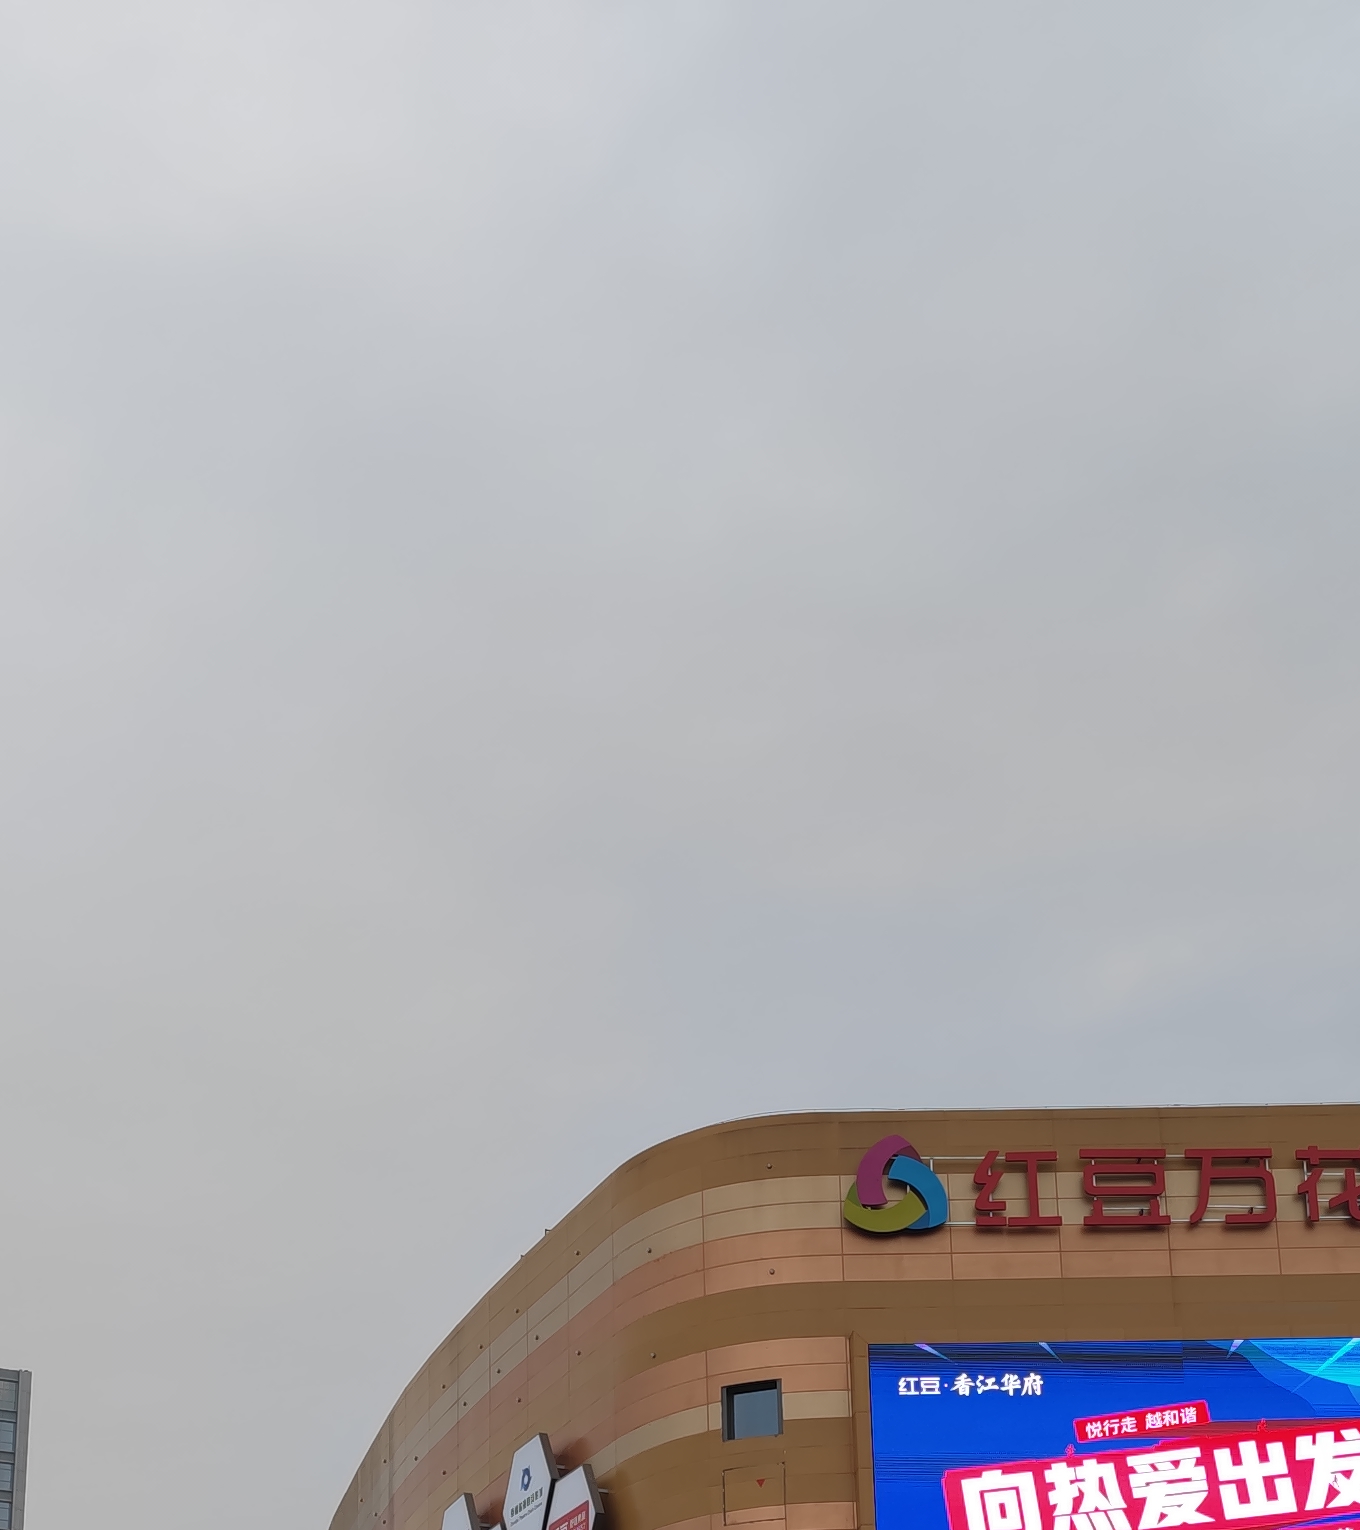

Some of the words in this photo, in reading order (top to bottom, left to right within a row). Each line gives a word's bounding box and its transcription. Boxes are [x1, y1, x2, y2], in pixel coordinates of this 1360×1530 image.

[1086, 1416, 1138, 1439] 悦行走
[1145, 1406, 1197, 1430] 越和谐
